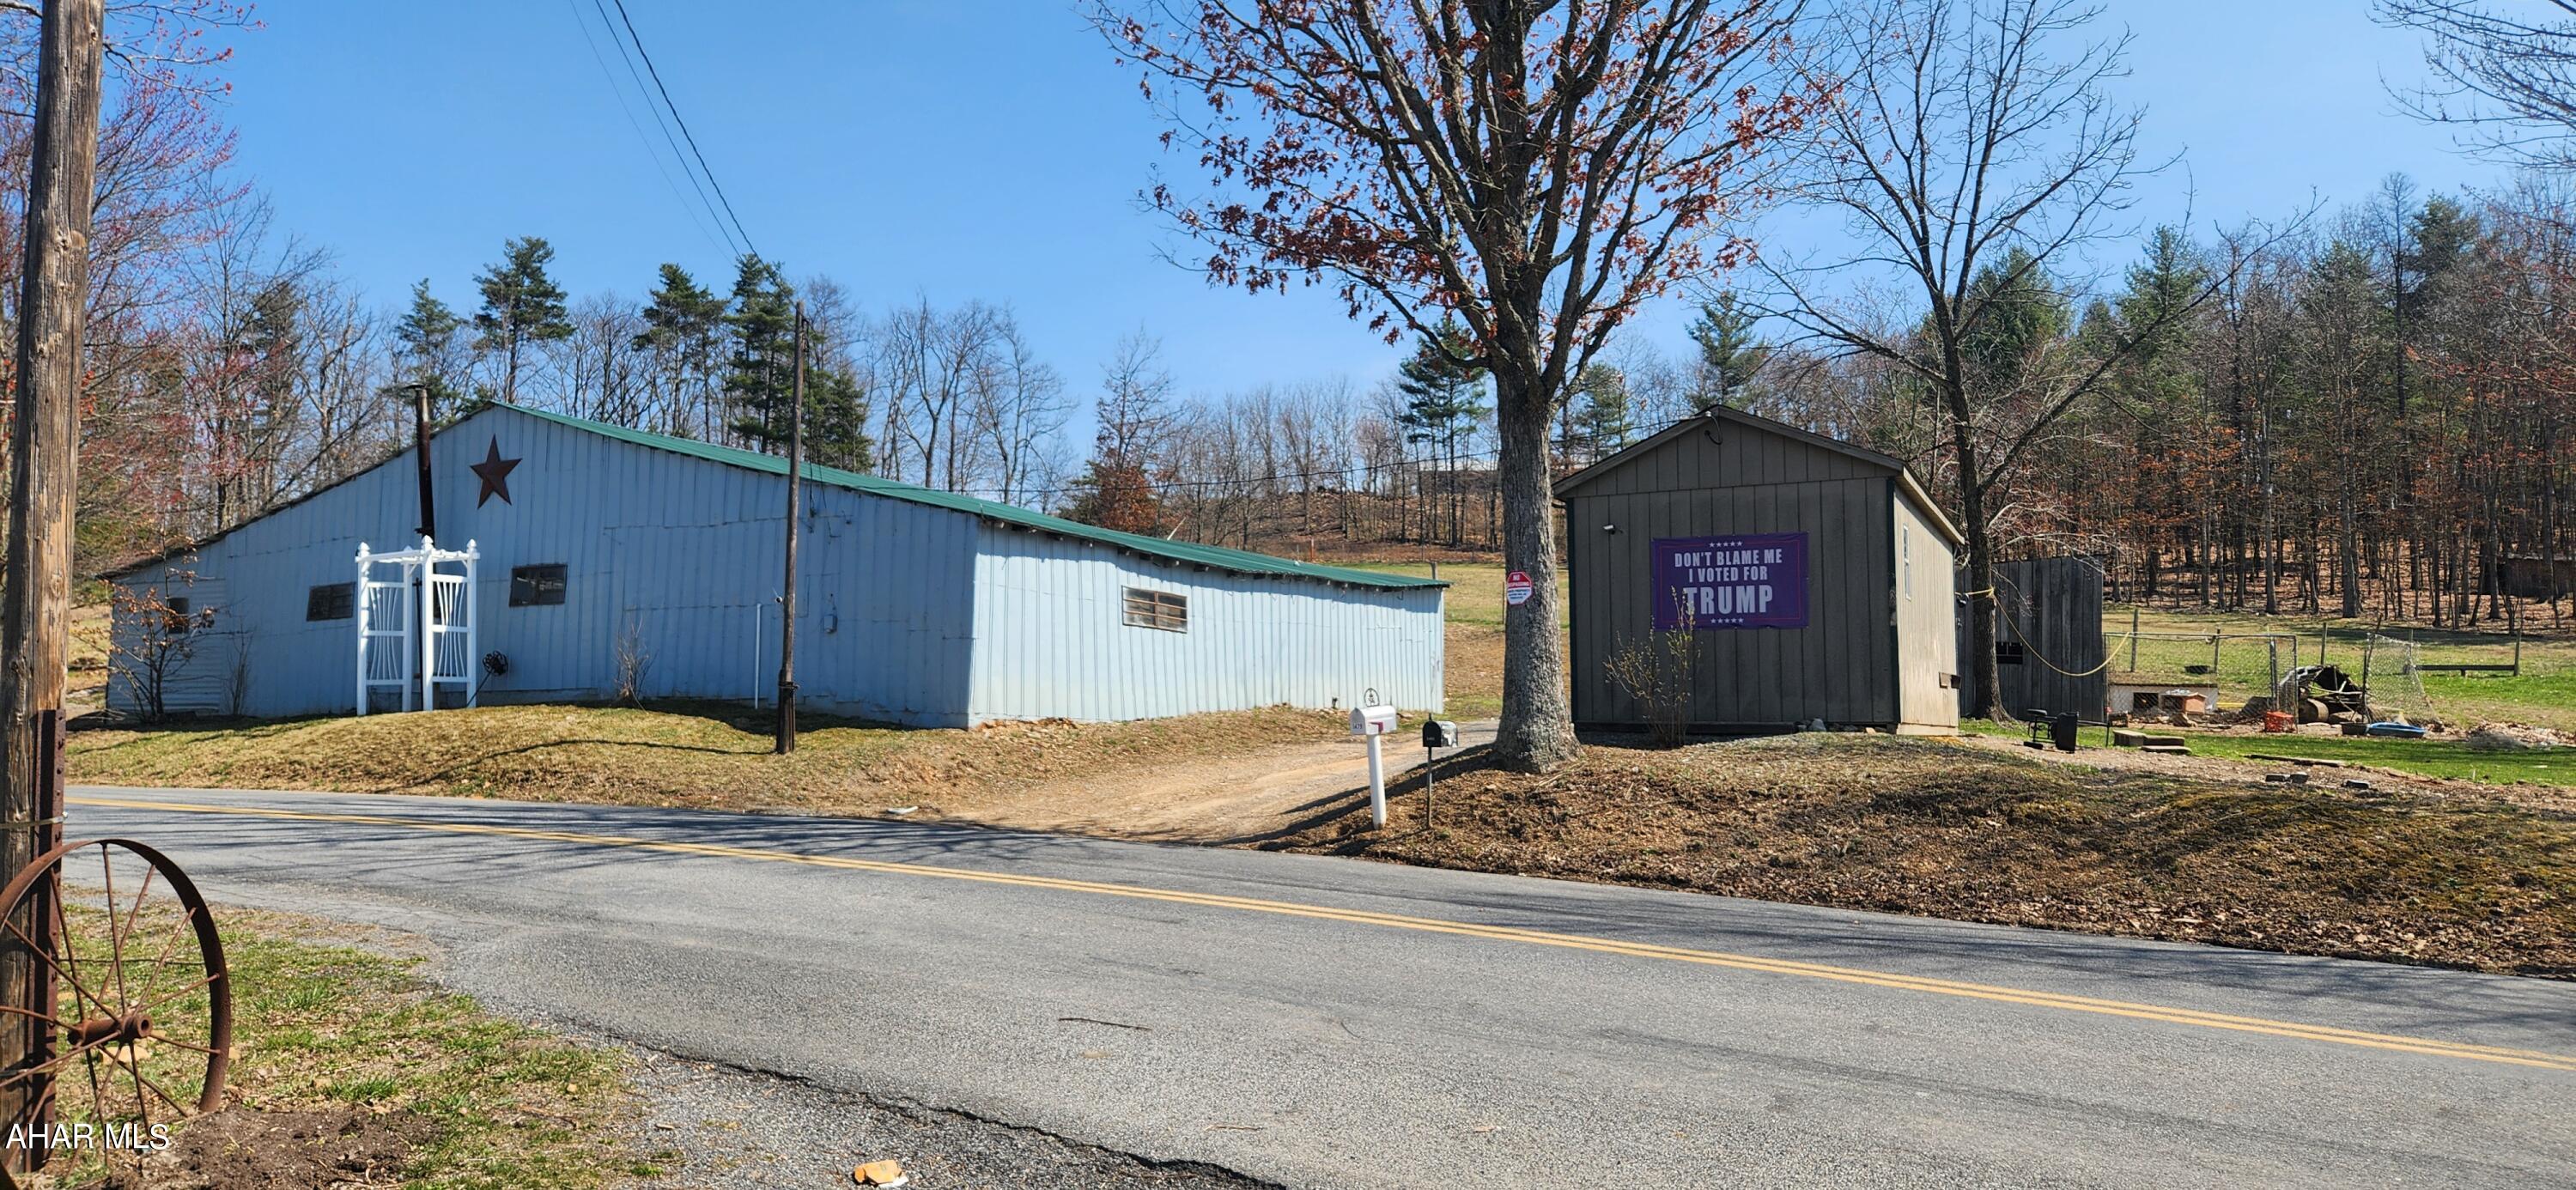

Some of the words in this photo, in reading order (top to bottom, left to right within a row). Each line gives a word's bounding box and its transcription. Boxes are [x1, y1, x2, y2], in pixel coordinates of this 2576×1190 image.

[1675, 552, 1711, 568] DON'T
[1716, 549, 1759, 566] BLAME
[1764, 549, 1783, 563] ME
[1689, 570, 1693, 583] I
[1698, 567, 1739, 582] VOTED
[1743, 566, 1768, 580] FOR
[1684, 585, 1773, 615] TRUMP
